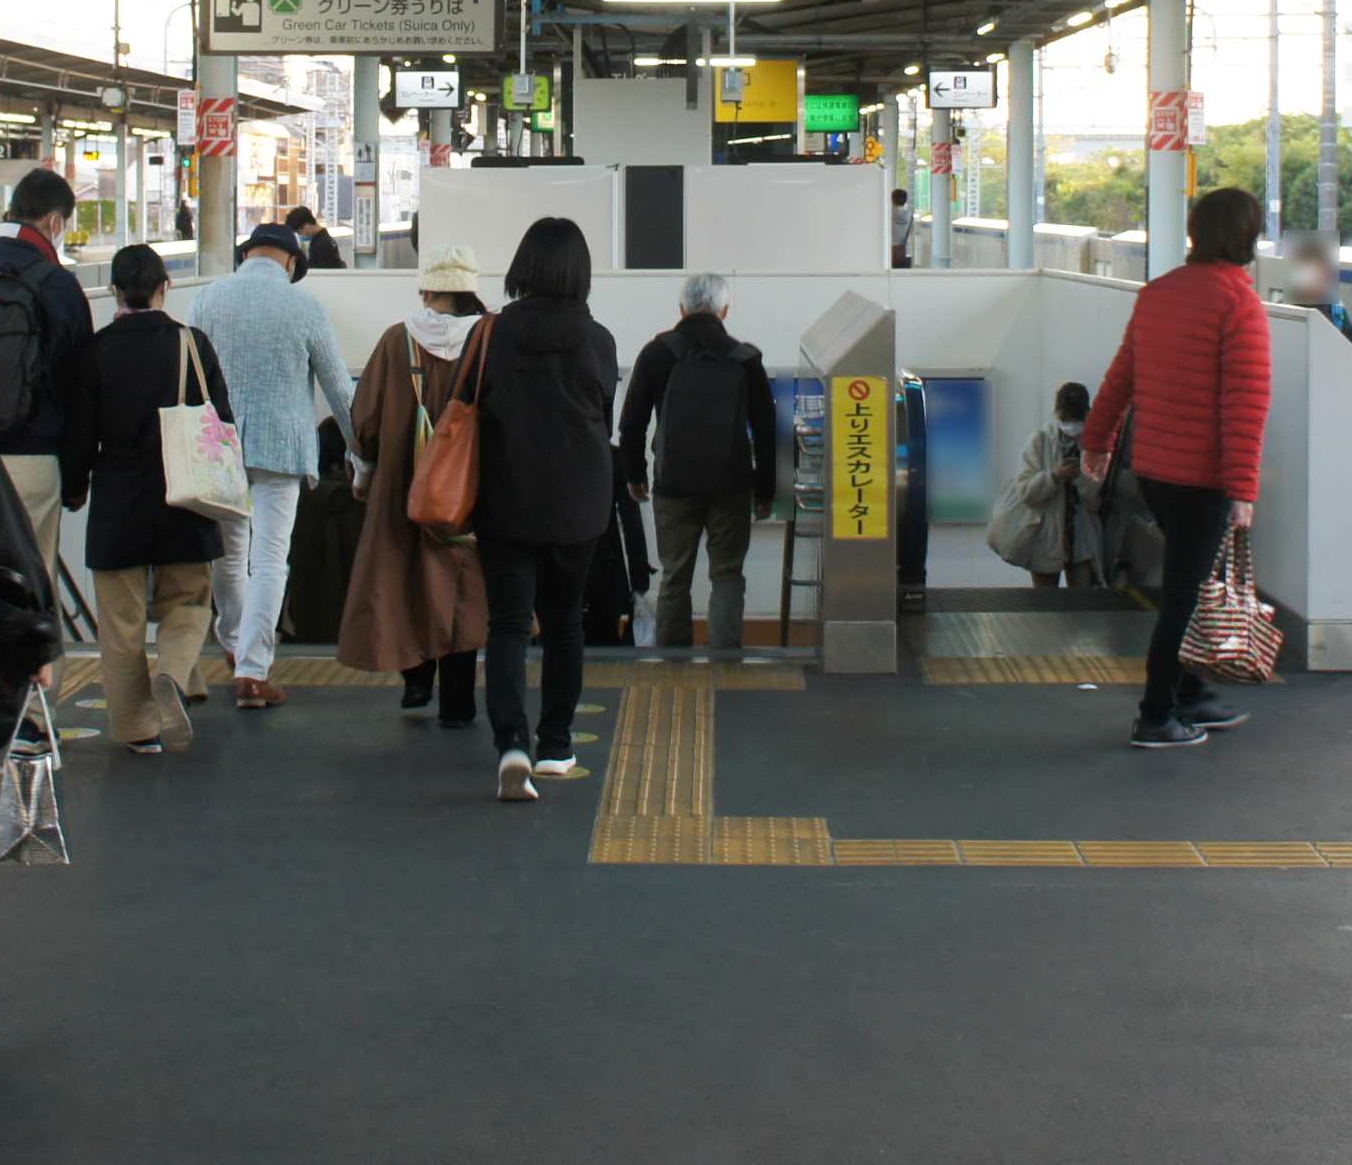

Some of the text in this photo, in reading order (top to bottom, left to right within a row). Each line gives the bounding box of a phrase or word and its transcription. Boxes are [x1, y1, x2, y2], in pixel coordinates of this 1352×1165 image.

[282, 18, 475, 34] Green Car Tickets (Suica Only)
[844, 402, 874, 535] 上りエスカレーター
